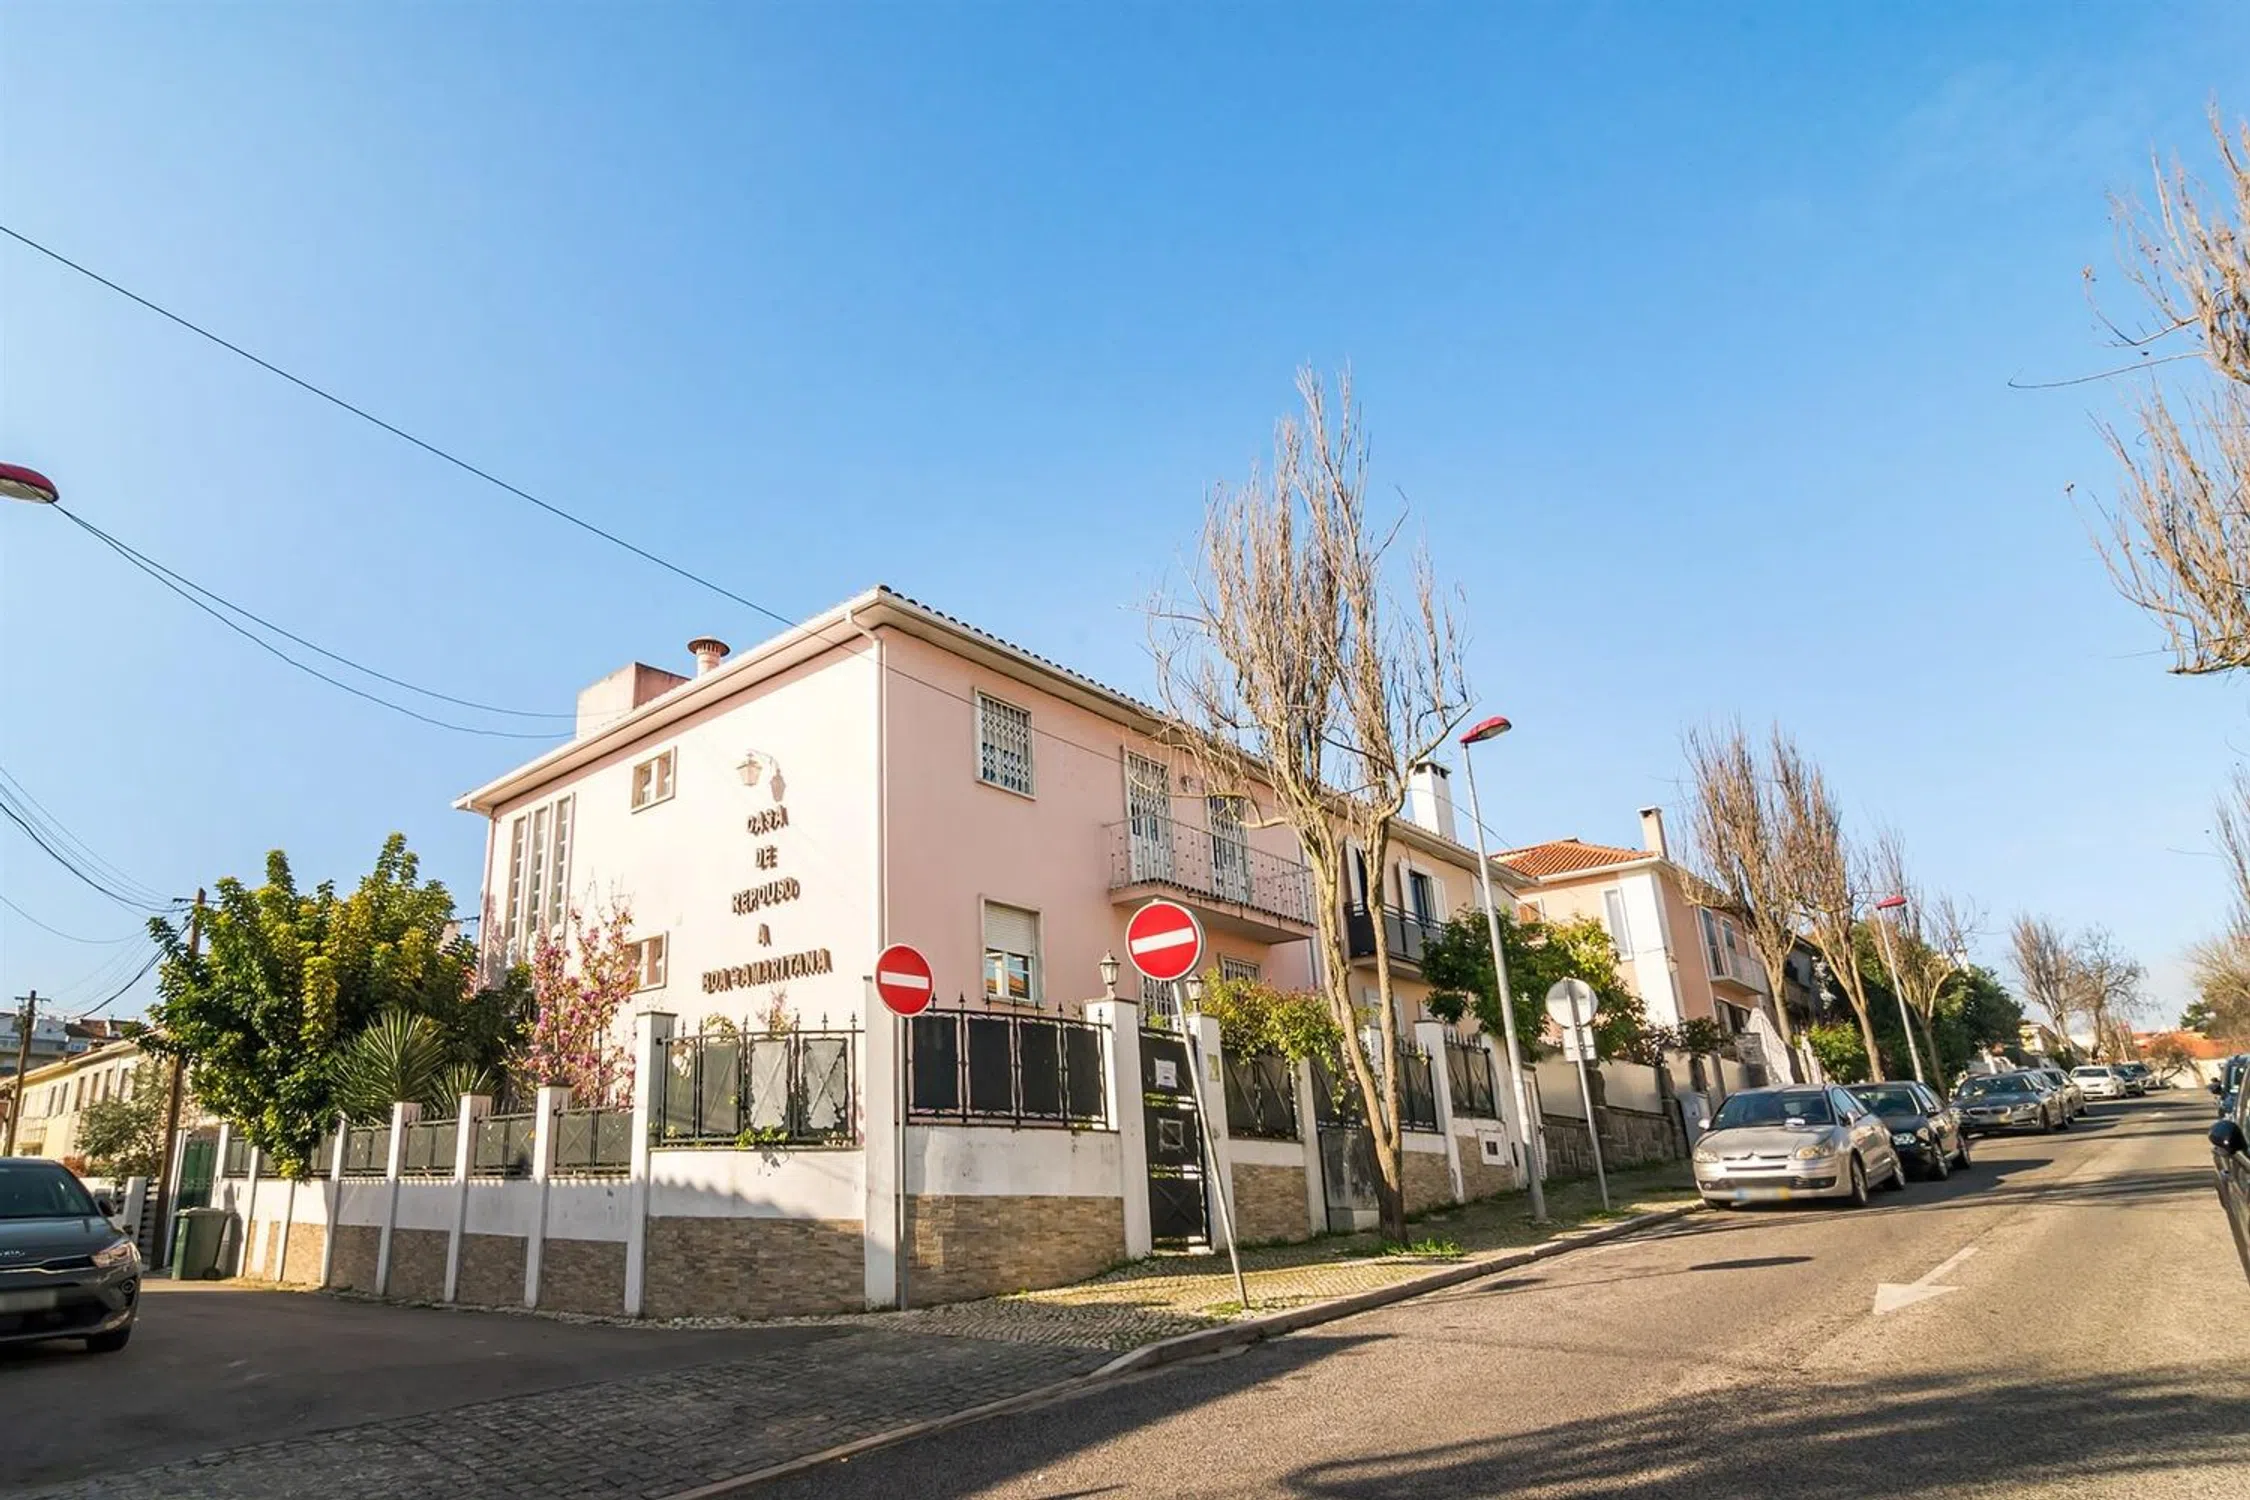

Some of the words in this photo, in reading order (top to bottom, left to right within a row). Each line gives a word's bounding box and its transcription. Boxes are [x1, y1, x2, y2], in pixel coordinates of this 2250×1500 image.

[747, 805, 788, 835] CASA
[755, 845, 778, 869] DE
[732, 877, 800, 915] REPOUSO
[758, 923, 771, 946] A
